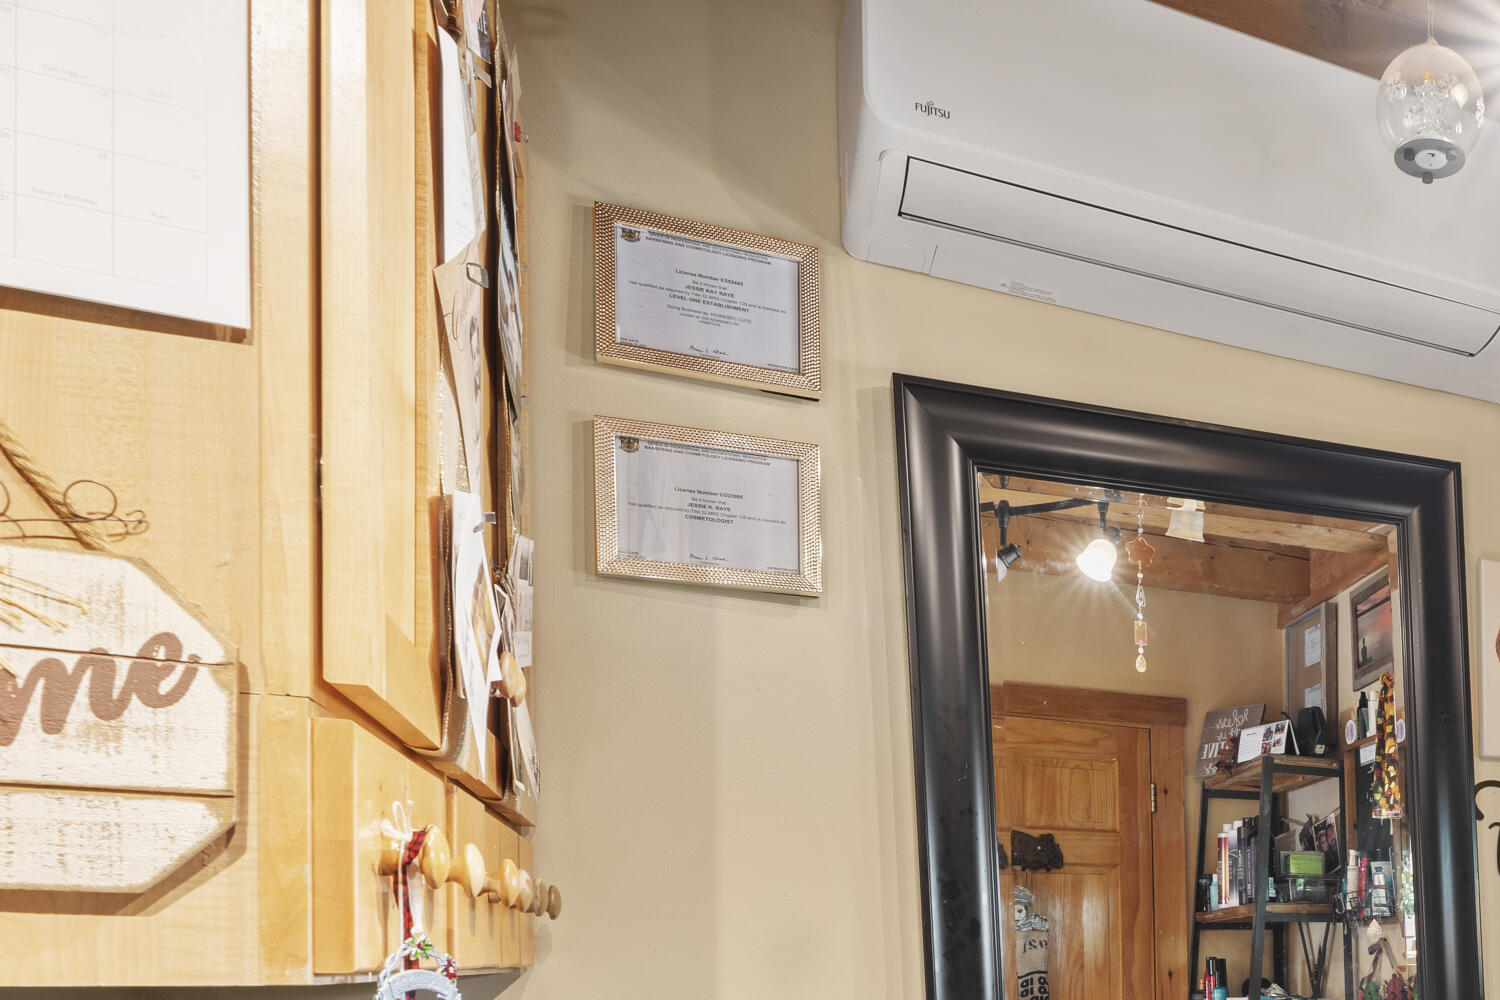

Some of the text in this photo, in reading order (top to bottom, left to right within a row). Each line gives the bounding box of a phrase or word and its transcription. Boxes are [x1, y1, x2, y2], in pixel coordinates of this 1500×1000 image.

[915, 101, 950, 119] FUJITSU
[676, 268, 697, 277] License
[698, 273, 719, 281] Number
[703, 300, 749, 312] ESTABLISHMENT
[685, 451, 721, 459] COSMETOLOGY
[685, 515, 733, 524] COSMETOLOGIST
